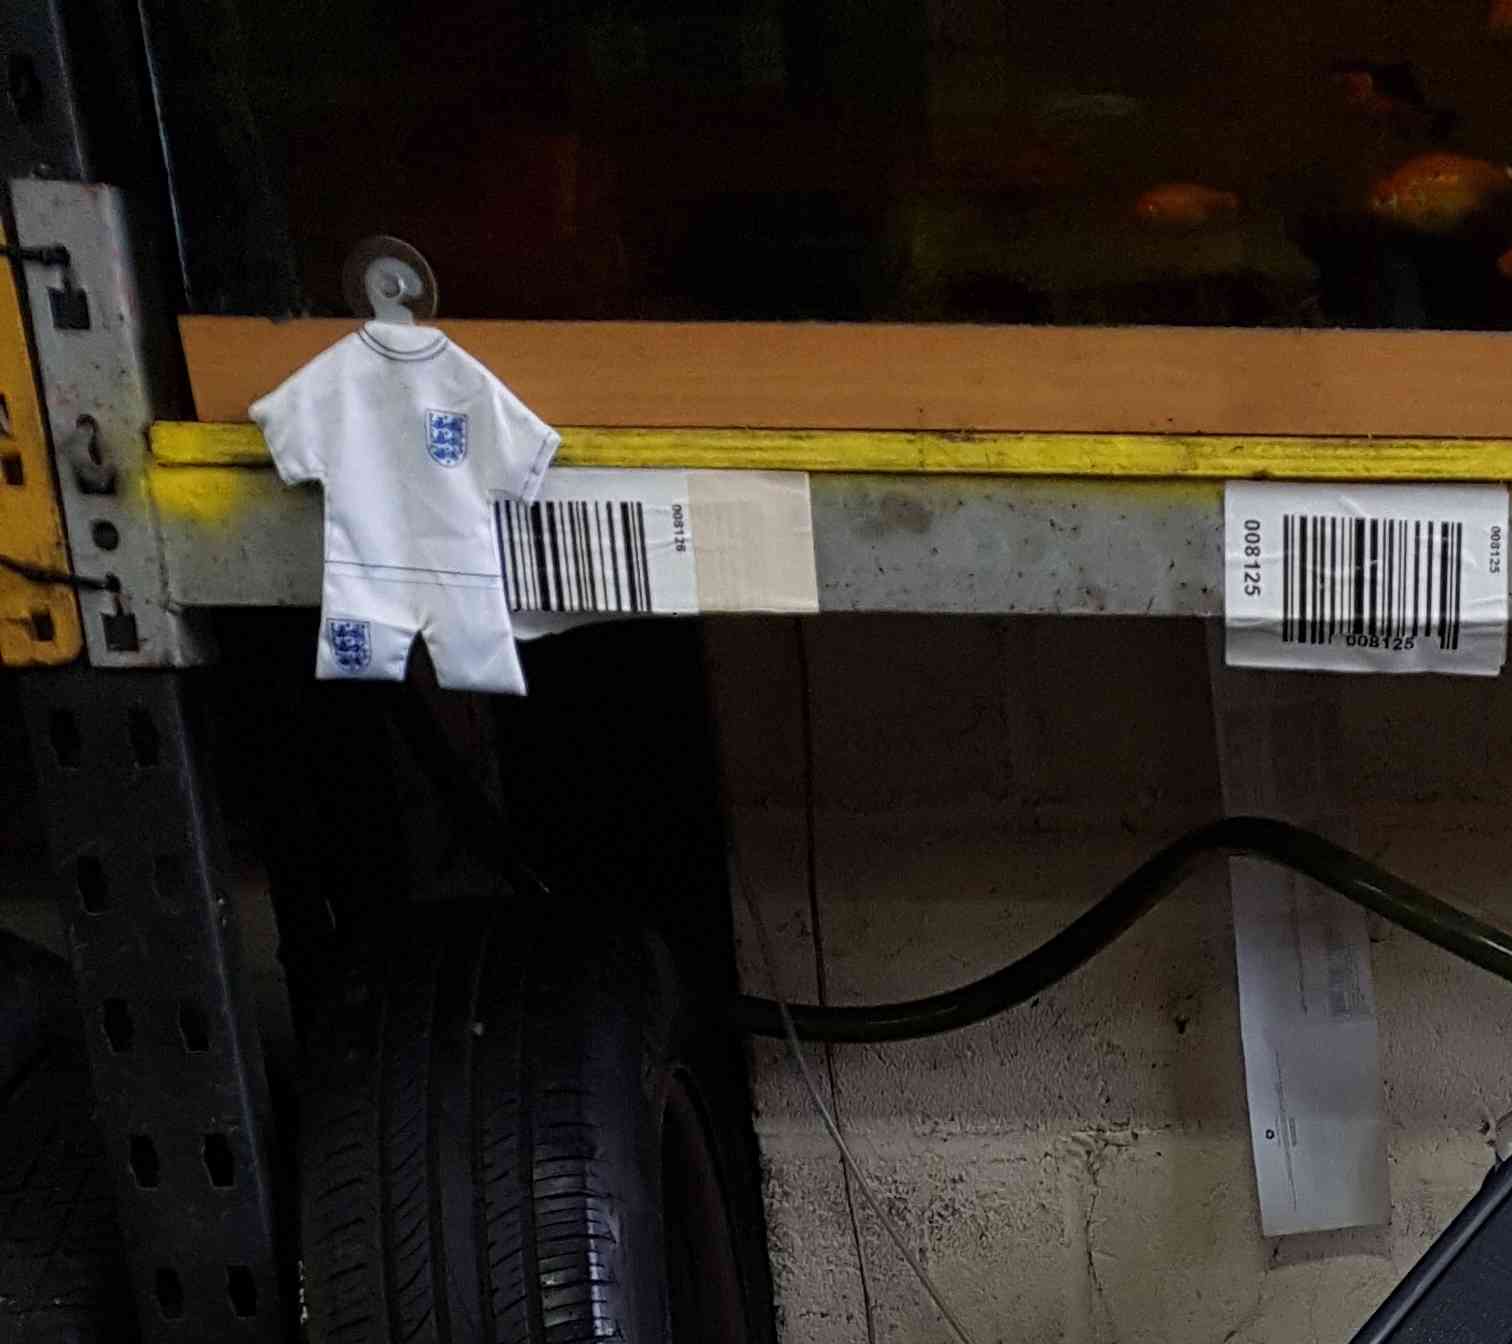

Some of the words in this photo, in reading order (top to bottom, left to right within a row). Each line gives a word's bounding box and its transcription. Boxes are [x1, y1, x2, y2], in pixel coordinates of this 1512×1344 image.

[672, 504, 686, 552] 008126
[1490, 526, 1502, 574] 008125
[1244, 519, 1261, 597] 008125
[1346, 634, 1415, 650] 008125
